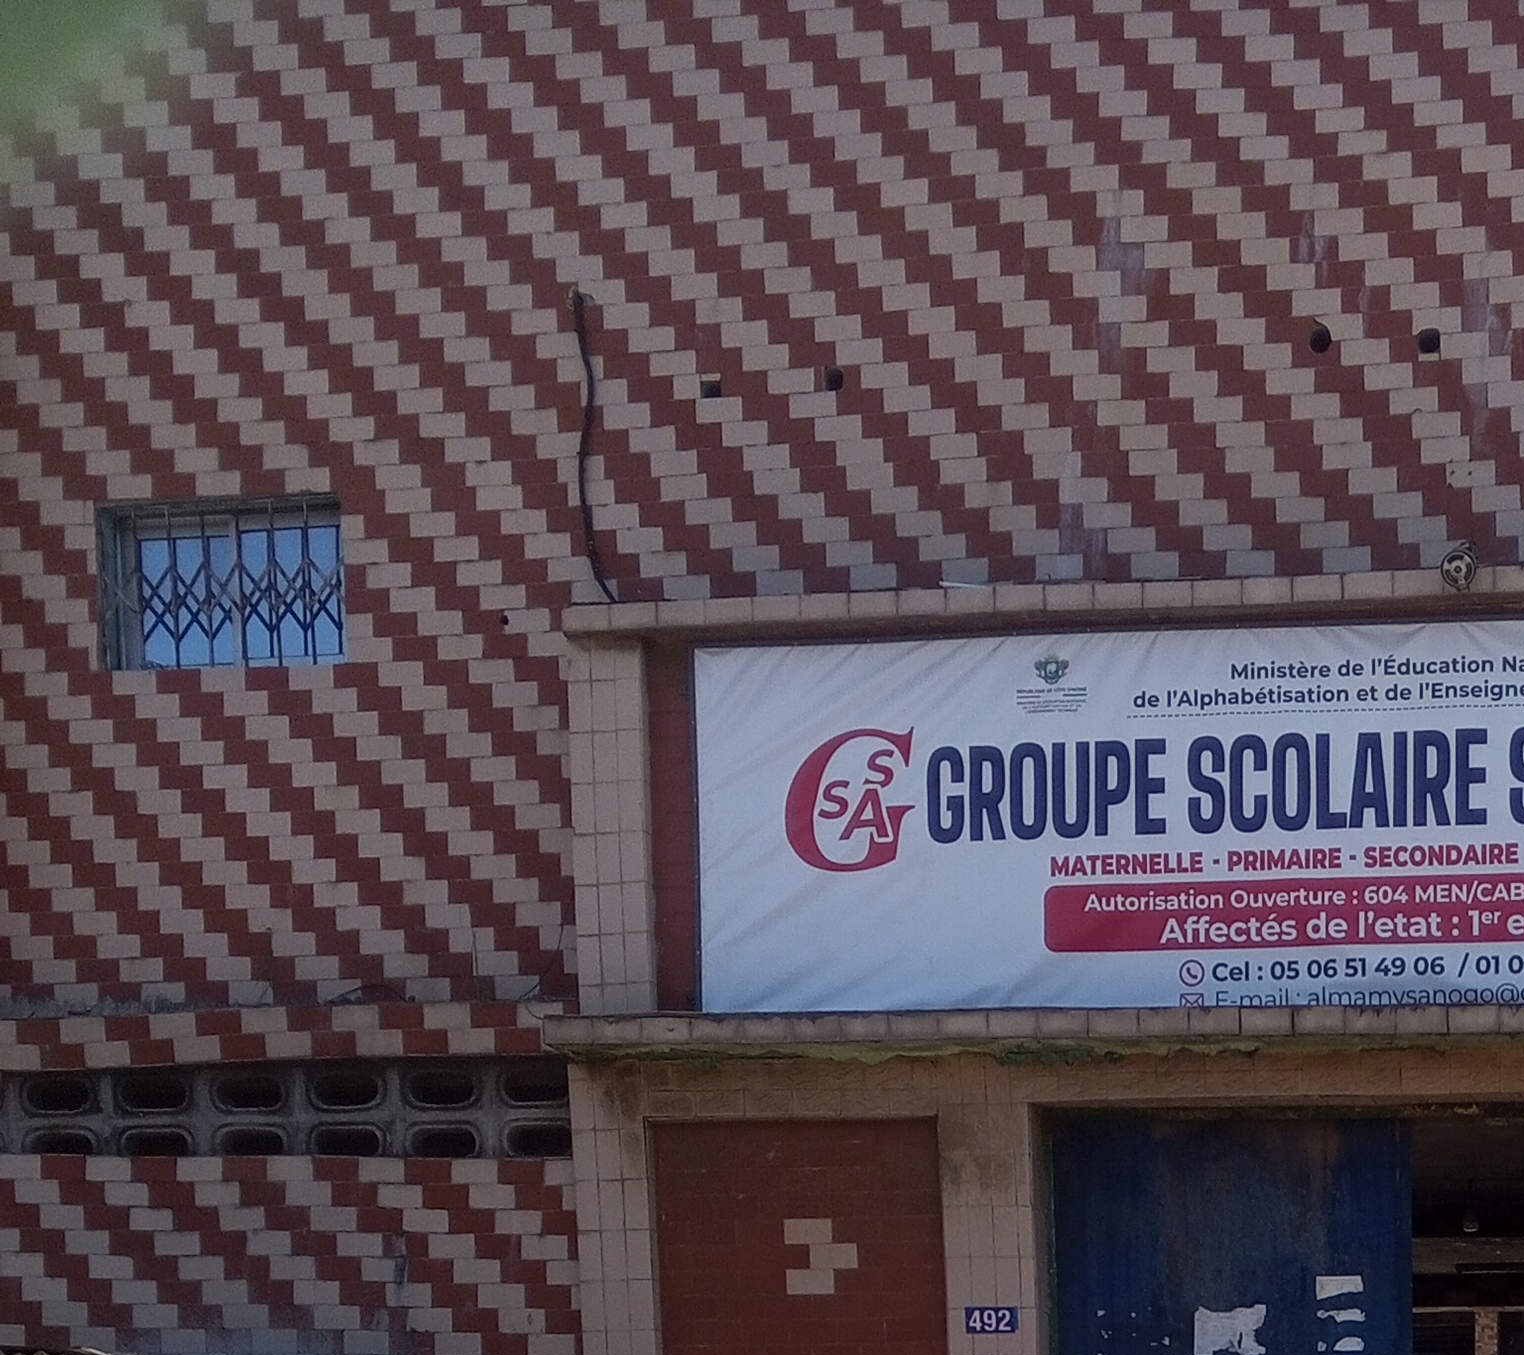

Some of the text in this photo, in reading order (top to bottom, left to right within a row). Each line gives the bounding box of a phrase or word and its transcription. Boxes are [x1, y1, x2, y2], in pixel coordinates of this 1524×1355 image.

[1230, 660, 1331, 680] Ministère
[1337, 659, 1364, 677] de
[1371, 654, 1494, 676] l'Éducation
[1133, 691, 1159, 708] de
[1167, 685, 1349, 710] l'Alphabétisation
[1356, 685, 1378, 702] et
[1385, 684, 1412, 701] de
[927, 738, 1166, 844] GROUPE
[1188, 728, 1487, 833] SCOLAIRE
[1050, 852, 1203, 877] MATERNELLE
[1227, 848, 1341, 871] PRIMAIRE
[1364, 843, 1518, 868] SECONDAIRE
[1084, 890, 1223, 912] Autorisation
[1230, 888, 1345, 909] Ouverture
[1364, 886, 1407, 904] 604
[1160, 913, 1297, 944] Affectés
[1307, 913, 1347, 939] de
[1358, 911, 1441, 938] l'etat
[1468, 910, 1500, 936] 1er
[1212, 963, 1249, 981] Cel
[1270, 961, 1299, 980] 05
[1307, 959, 1337, 978] 06
[1344, 958, 1366, 977] 51
[1374, 957, 1405, 976] 49
[1413, 957, 1445, 975] 06
[969, 1310, 1012, 1331] 492
